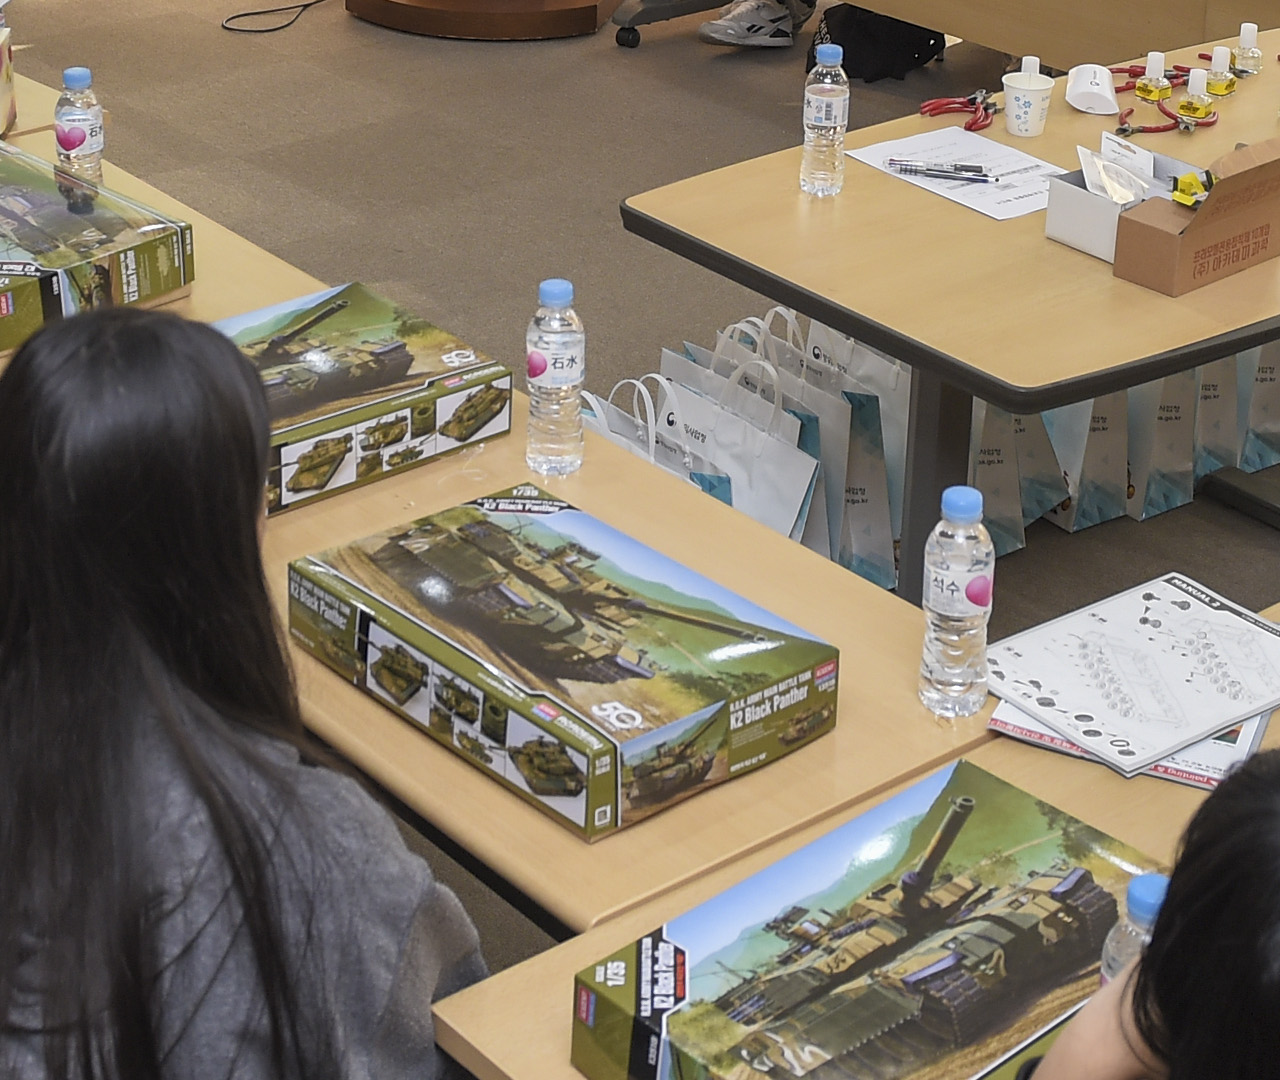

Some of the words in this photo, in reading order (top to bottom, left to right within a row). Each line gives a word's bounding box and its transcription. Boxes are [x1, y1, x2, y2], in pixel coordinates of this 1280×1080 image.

[1192, 260, 1209, 280] (주)
[551, 354, 578, 370] 石水
[932, 575, 960, 596] 석수
[1171, 578, 1210, 607] MANUAL
[299, 586, 320, 614] Black
[591, 701, 643, 730] 50
[730, 710, 744, 731] K2
[745, 698, 772, 725] Black
[773, 684, 809, 713] Panther
[1167, 767, 1210, 783] painting
[606, 960, 626, 987] 1/35
